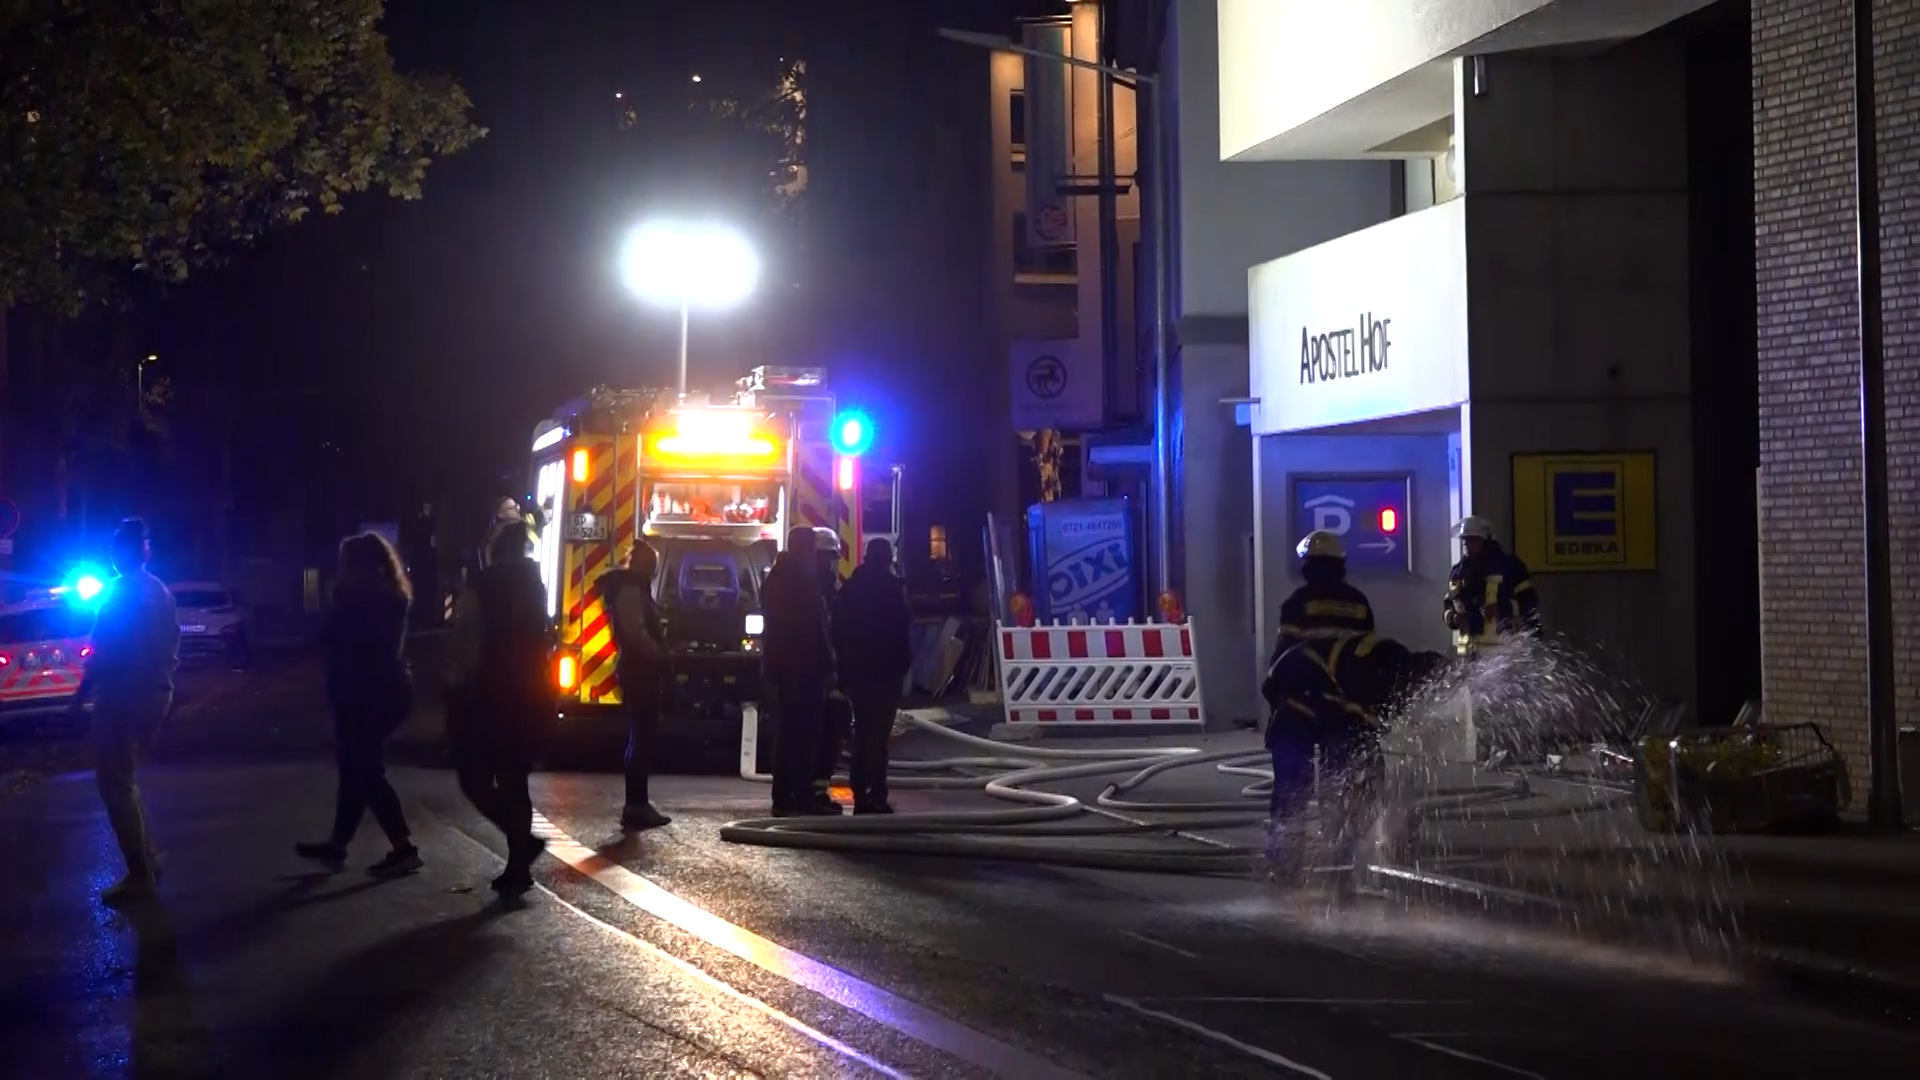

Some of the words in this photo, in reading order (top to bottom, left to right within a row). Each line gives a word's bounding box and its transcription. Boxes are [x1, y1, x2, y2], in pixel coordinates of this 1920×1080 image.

[1300, 325, 1359, 385] APOSTEL
[1360, 311, 1391, 374] HOF
[1554, 472, 1616, 535] E
[1554, 542, 1619, 555] EDEKA
